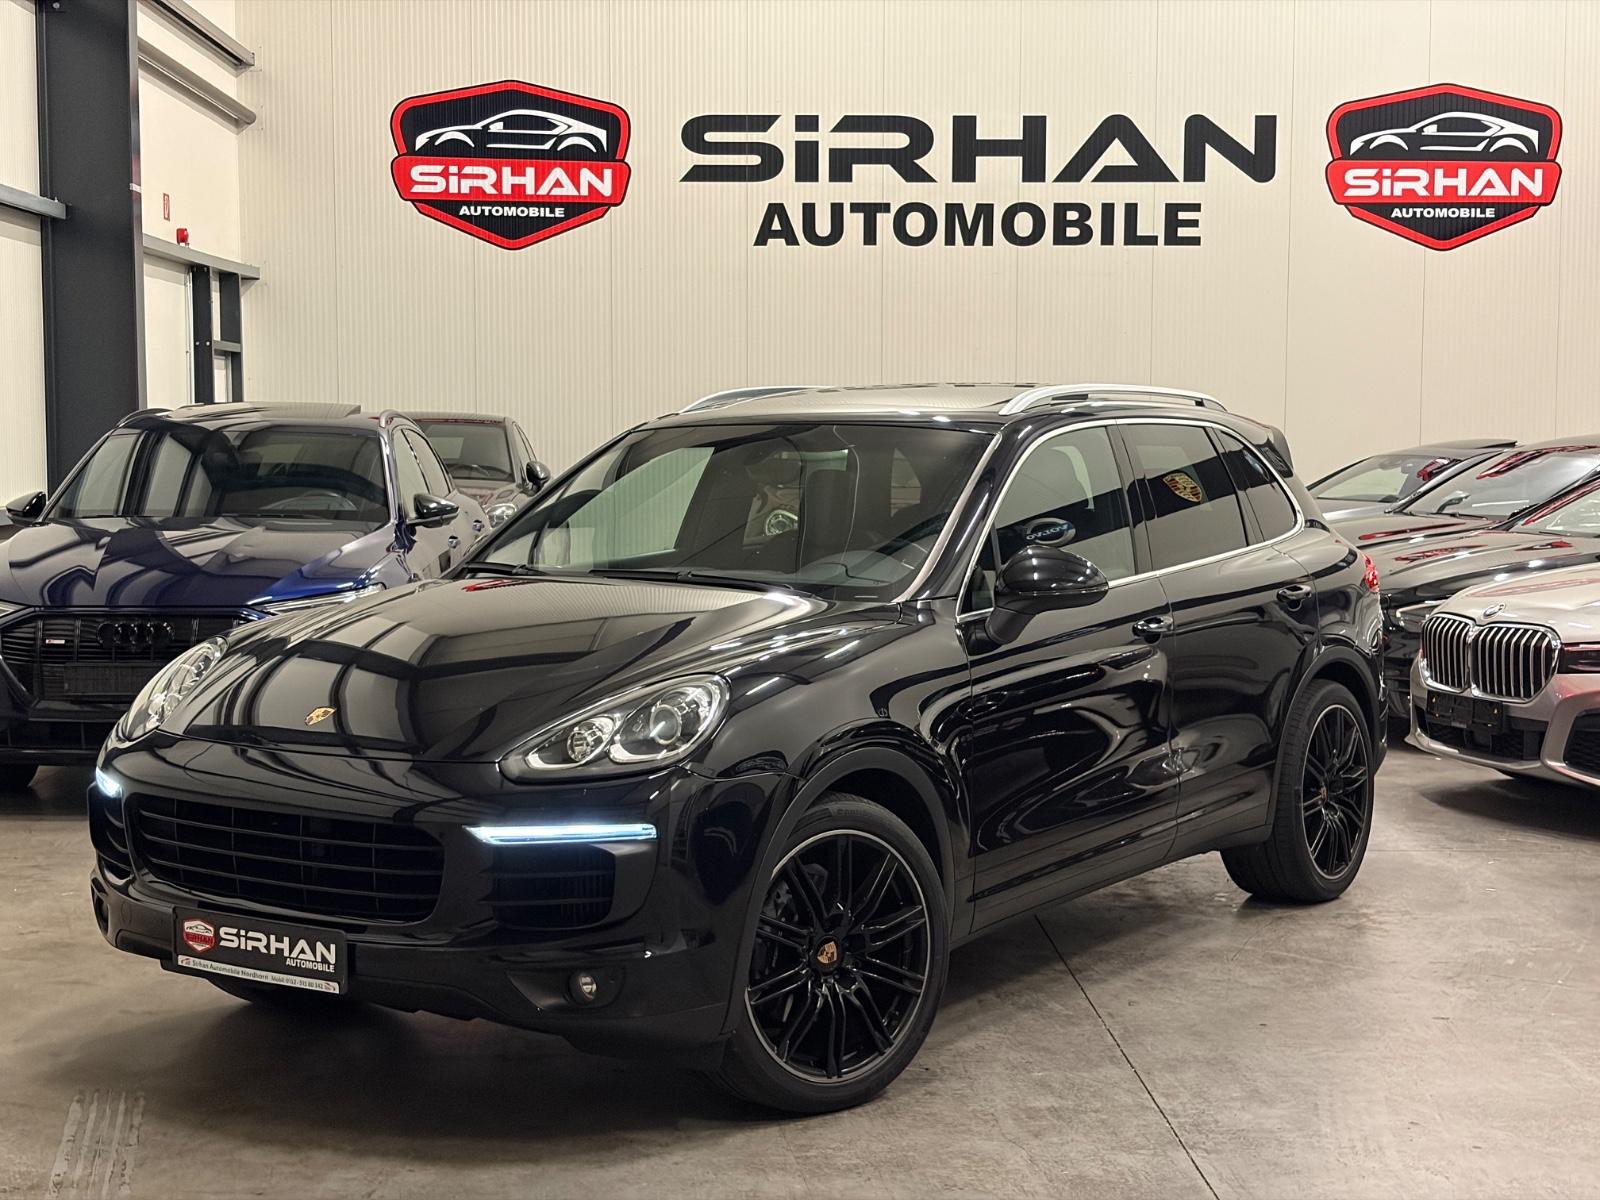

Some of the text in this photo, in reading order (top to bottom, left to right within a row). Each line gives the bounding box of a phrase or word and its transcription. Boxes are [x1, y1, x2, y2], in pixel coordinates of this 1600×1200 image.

[459, 205, 565, 218] AUTOMOBILE
[1391, 207, 1495, 218] AUTOMOBILE
[753, 201, 1202, 247] AUTOMOBILE
[286, 957, 335, 973] AUTOMOBILE
